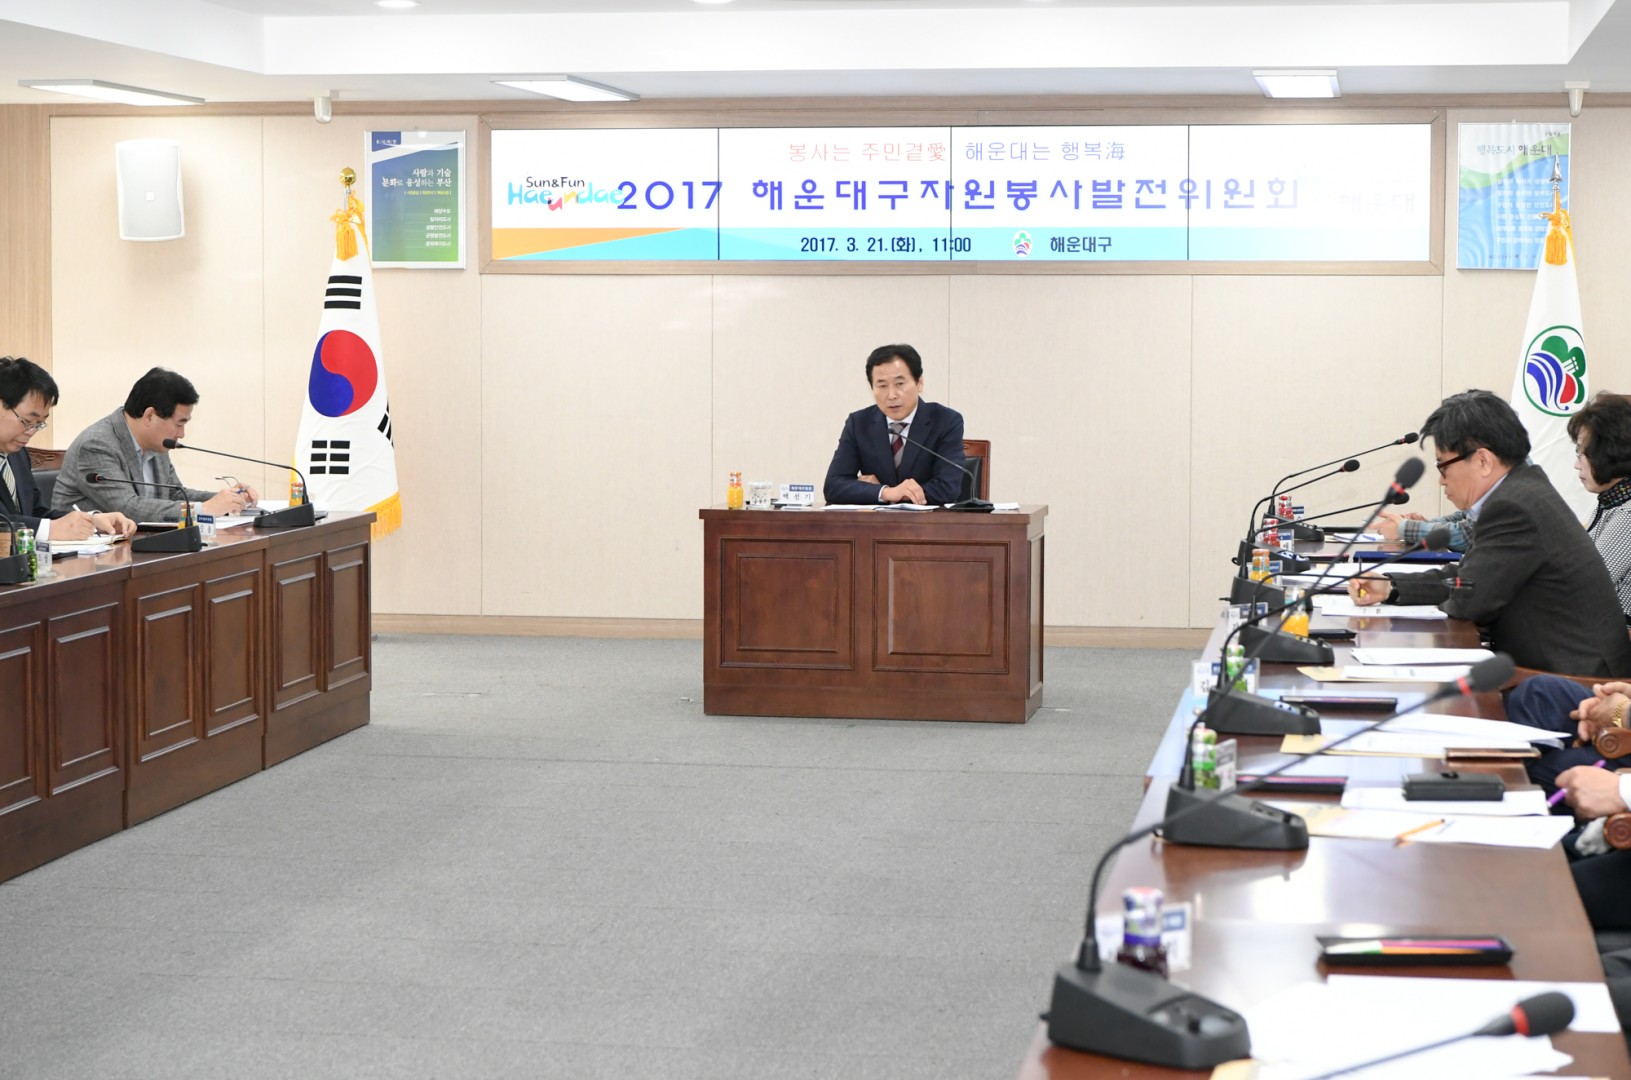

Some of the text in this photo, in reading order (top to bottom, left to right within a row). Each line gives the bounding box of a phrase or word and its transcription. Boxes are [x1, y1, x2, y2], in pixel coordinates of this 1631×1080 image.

[789, 141, 1125, 162] 봉사는 주민곁愛 해운대는 행복海
[1518, 144, 1552, 156] 해운대
[436, 178, 452, 187] 부산
[526, 176, 585, 188] Sun&Fun
[617, 181, 723, 210] 2017
[800, 237, 839, 252] 2017.
[846, 237, 859, 252] 3.
[932, 237, 971, 252] 11:00
[1050, 236, 1113, 253] 해운대구
